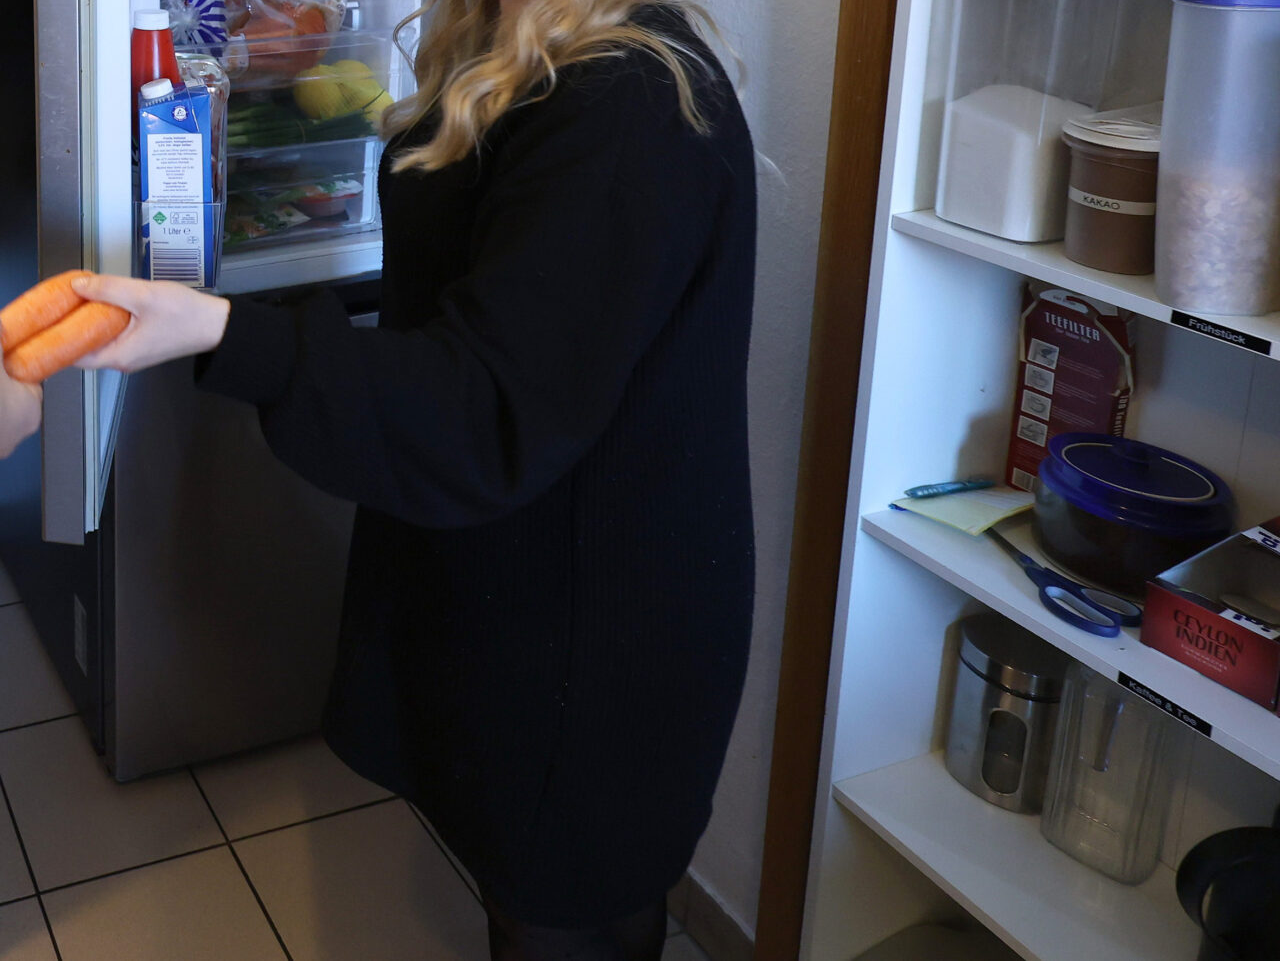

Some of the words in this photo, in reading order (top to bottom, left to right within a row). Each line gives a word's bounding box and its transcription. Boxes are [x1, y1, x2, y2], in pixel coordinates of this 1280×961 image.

[1083, 195, 1120, 210] KAKAO
[168, 227, 181, 235] Liter
[1044, 311, 1100, 342] TEEFILTER
[1188, 318, 1246, 345] Frühstück
[1174, 609, 1244, 654] CEYLON
[1176, 625, 1237, 667] INDIEN
[1128, 680, 1163, 706] Kaffee
[1176, 708, 1197, 726] Tee
